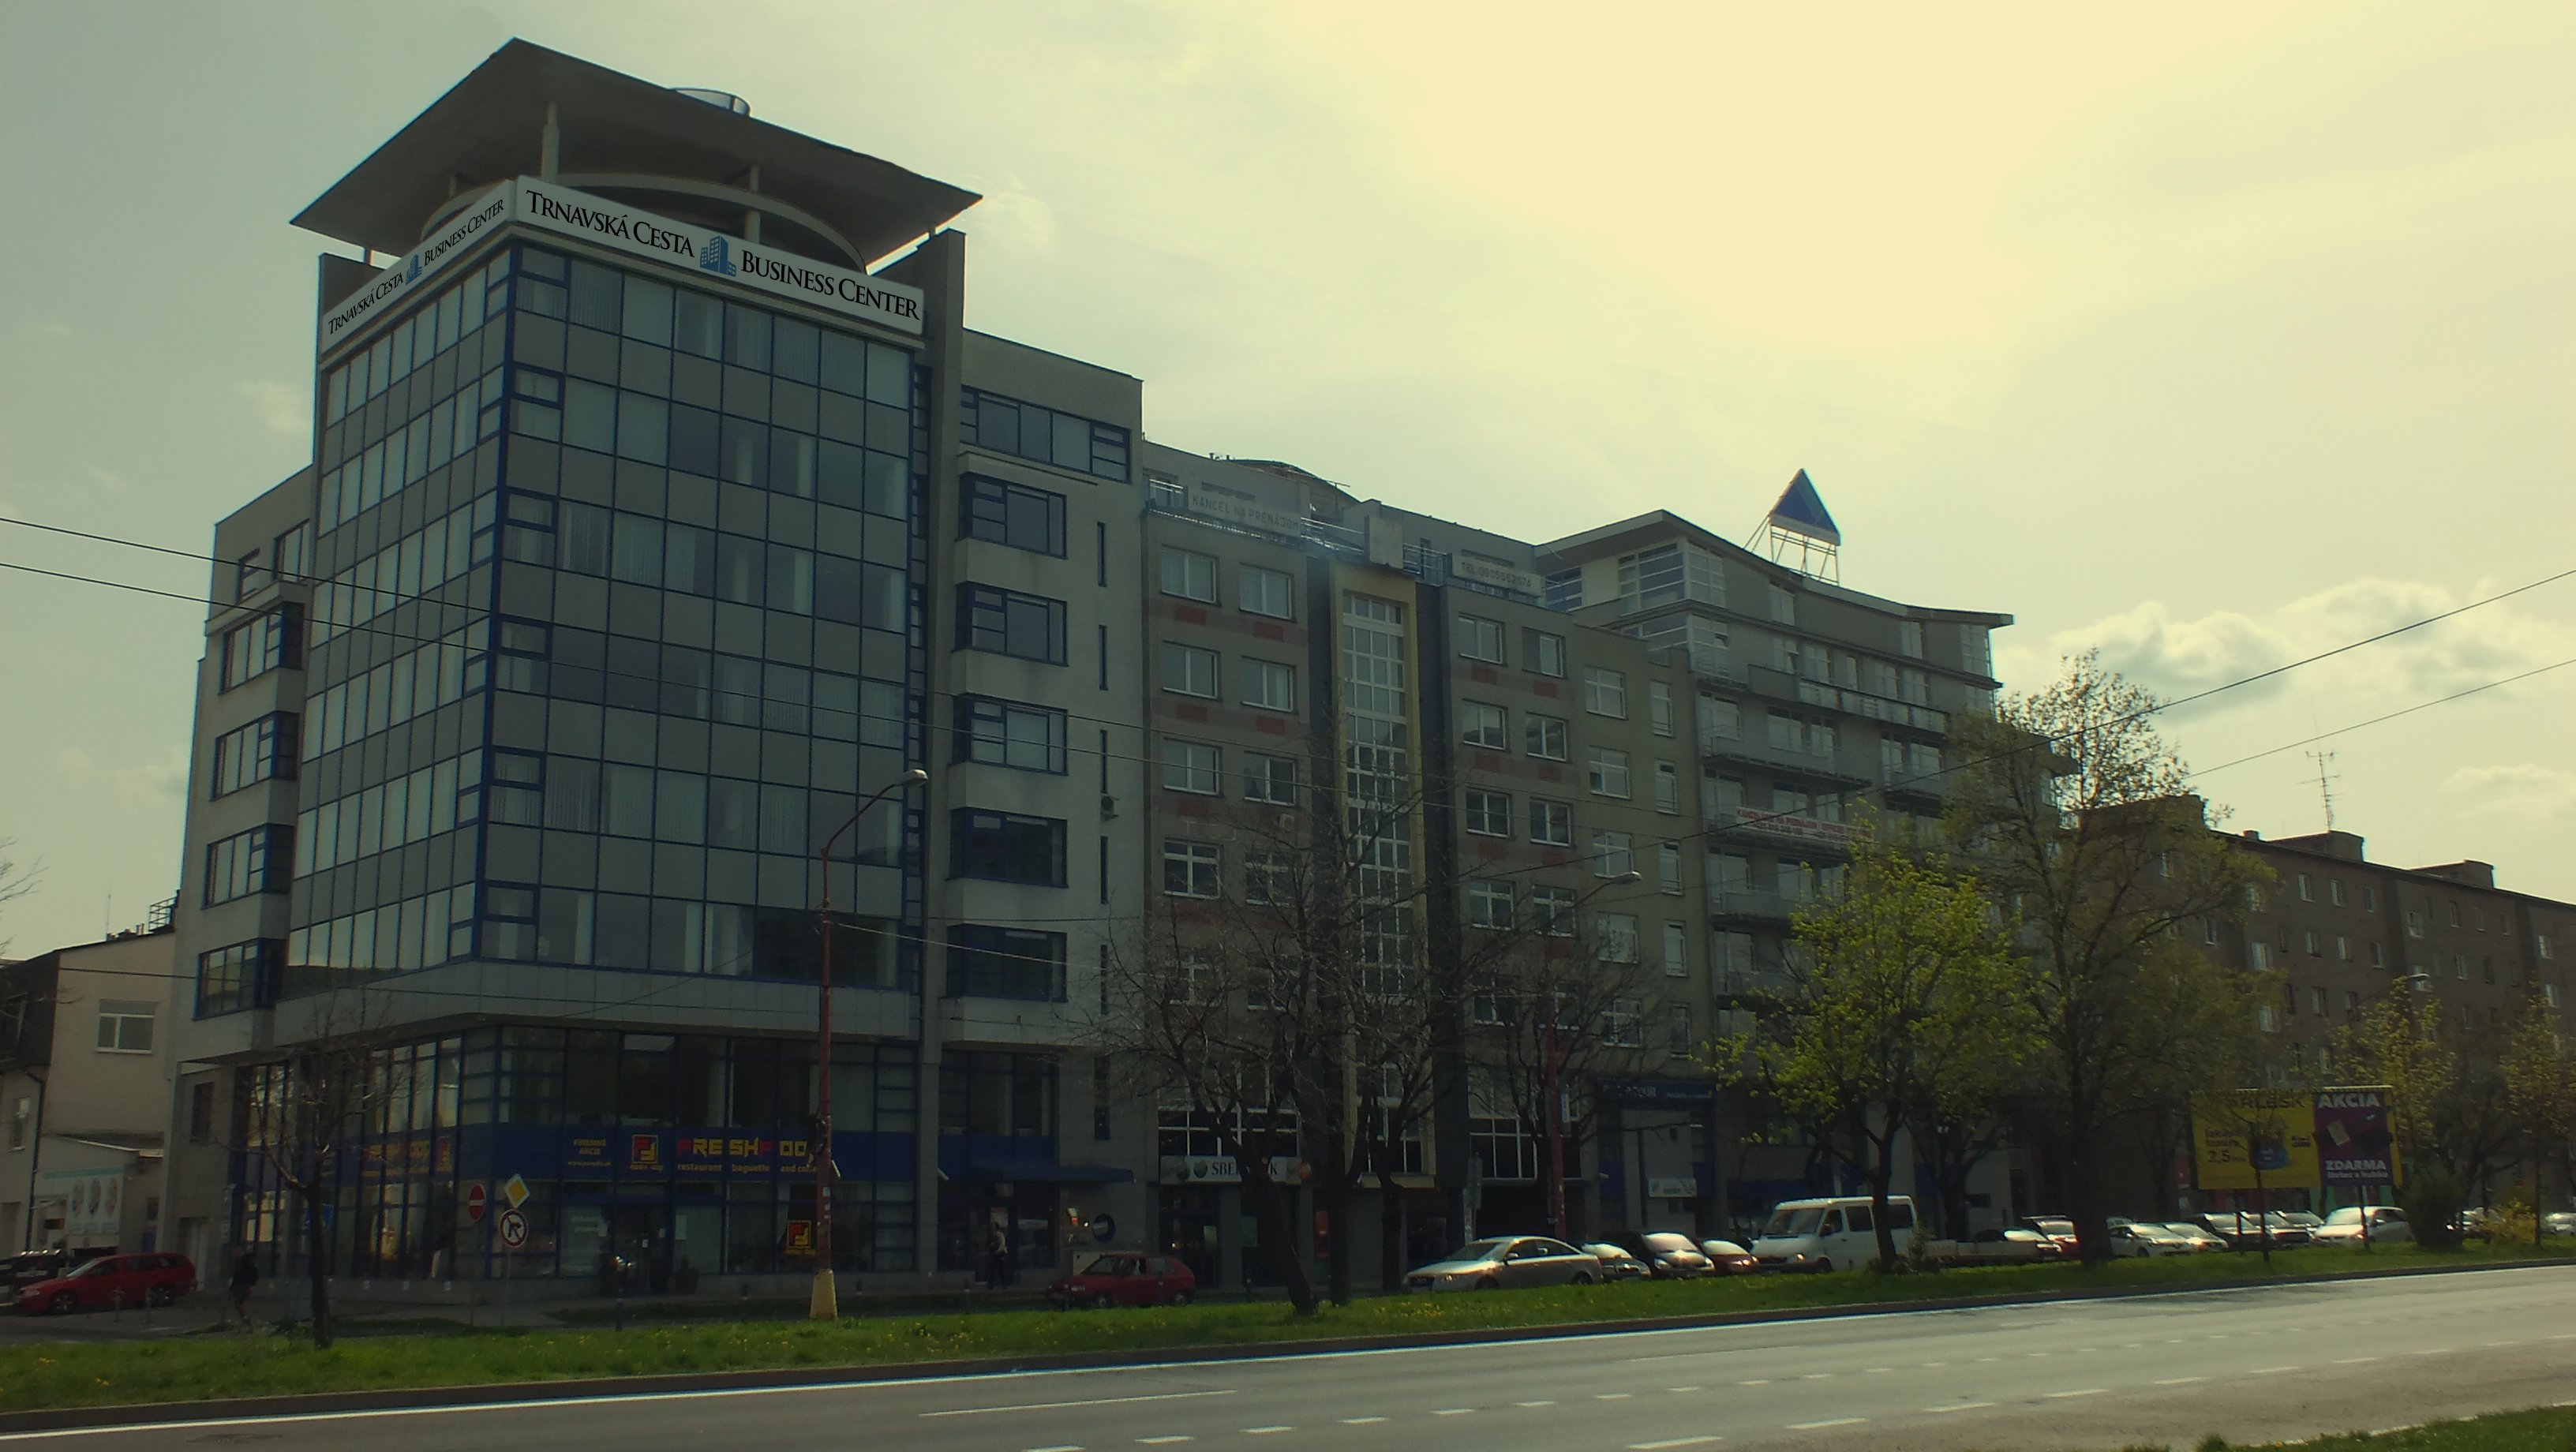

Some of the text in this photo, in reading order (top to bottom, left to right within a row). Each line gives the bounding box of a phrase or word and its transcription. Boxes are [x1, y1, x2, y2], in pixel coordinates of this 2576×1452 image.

[376, 272, 404, 300] CESTA
[424, 225, 466, 267] BUSINESS
[467, 199, 504, 234] CENTER
[633, 221, 695, 258] CESTA
[741, 249, 835, 296] BUSINESS
[838, 278, 921, 321] CENTER
[2318, 1093, 2381, 1108] AKCIA
[2325, 1159, 2387, 1170] ZDARMA
